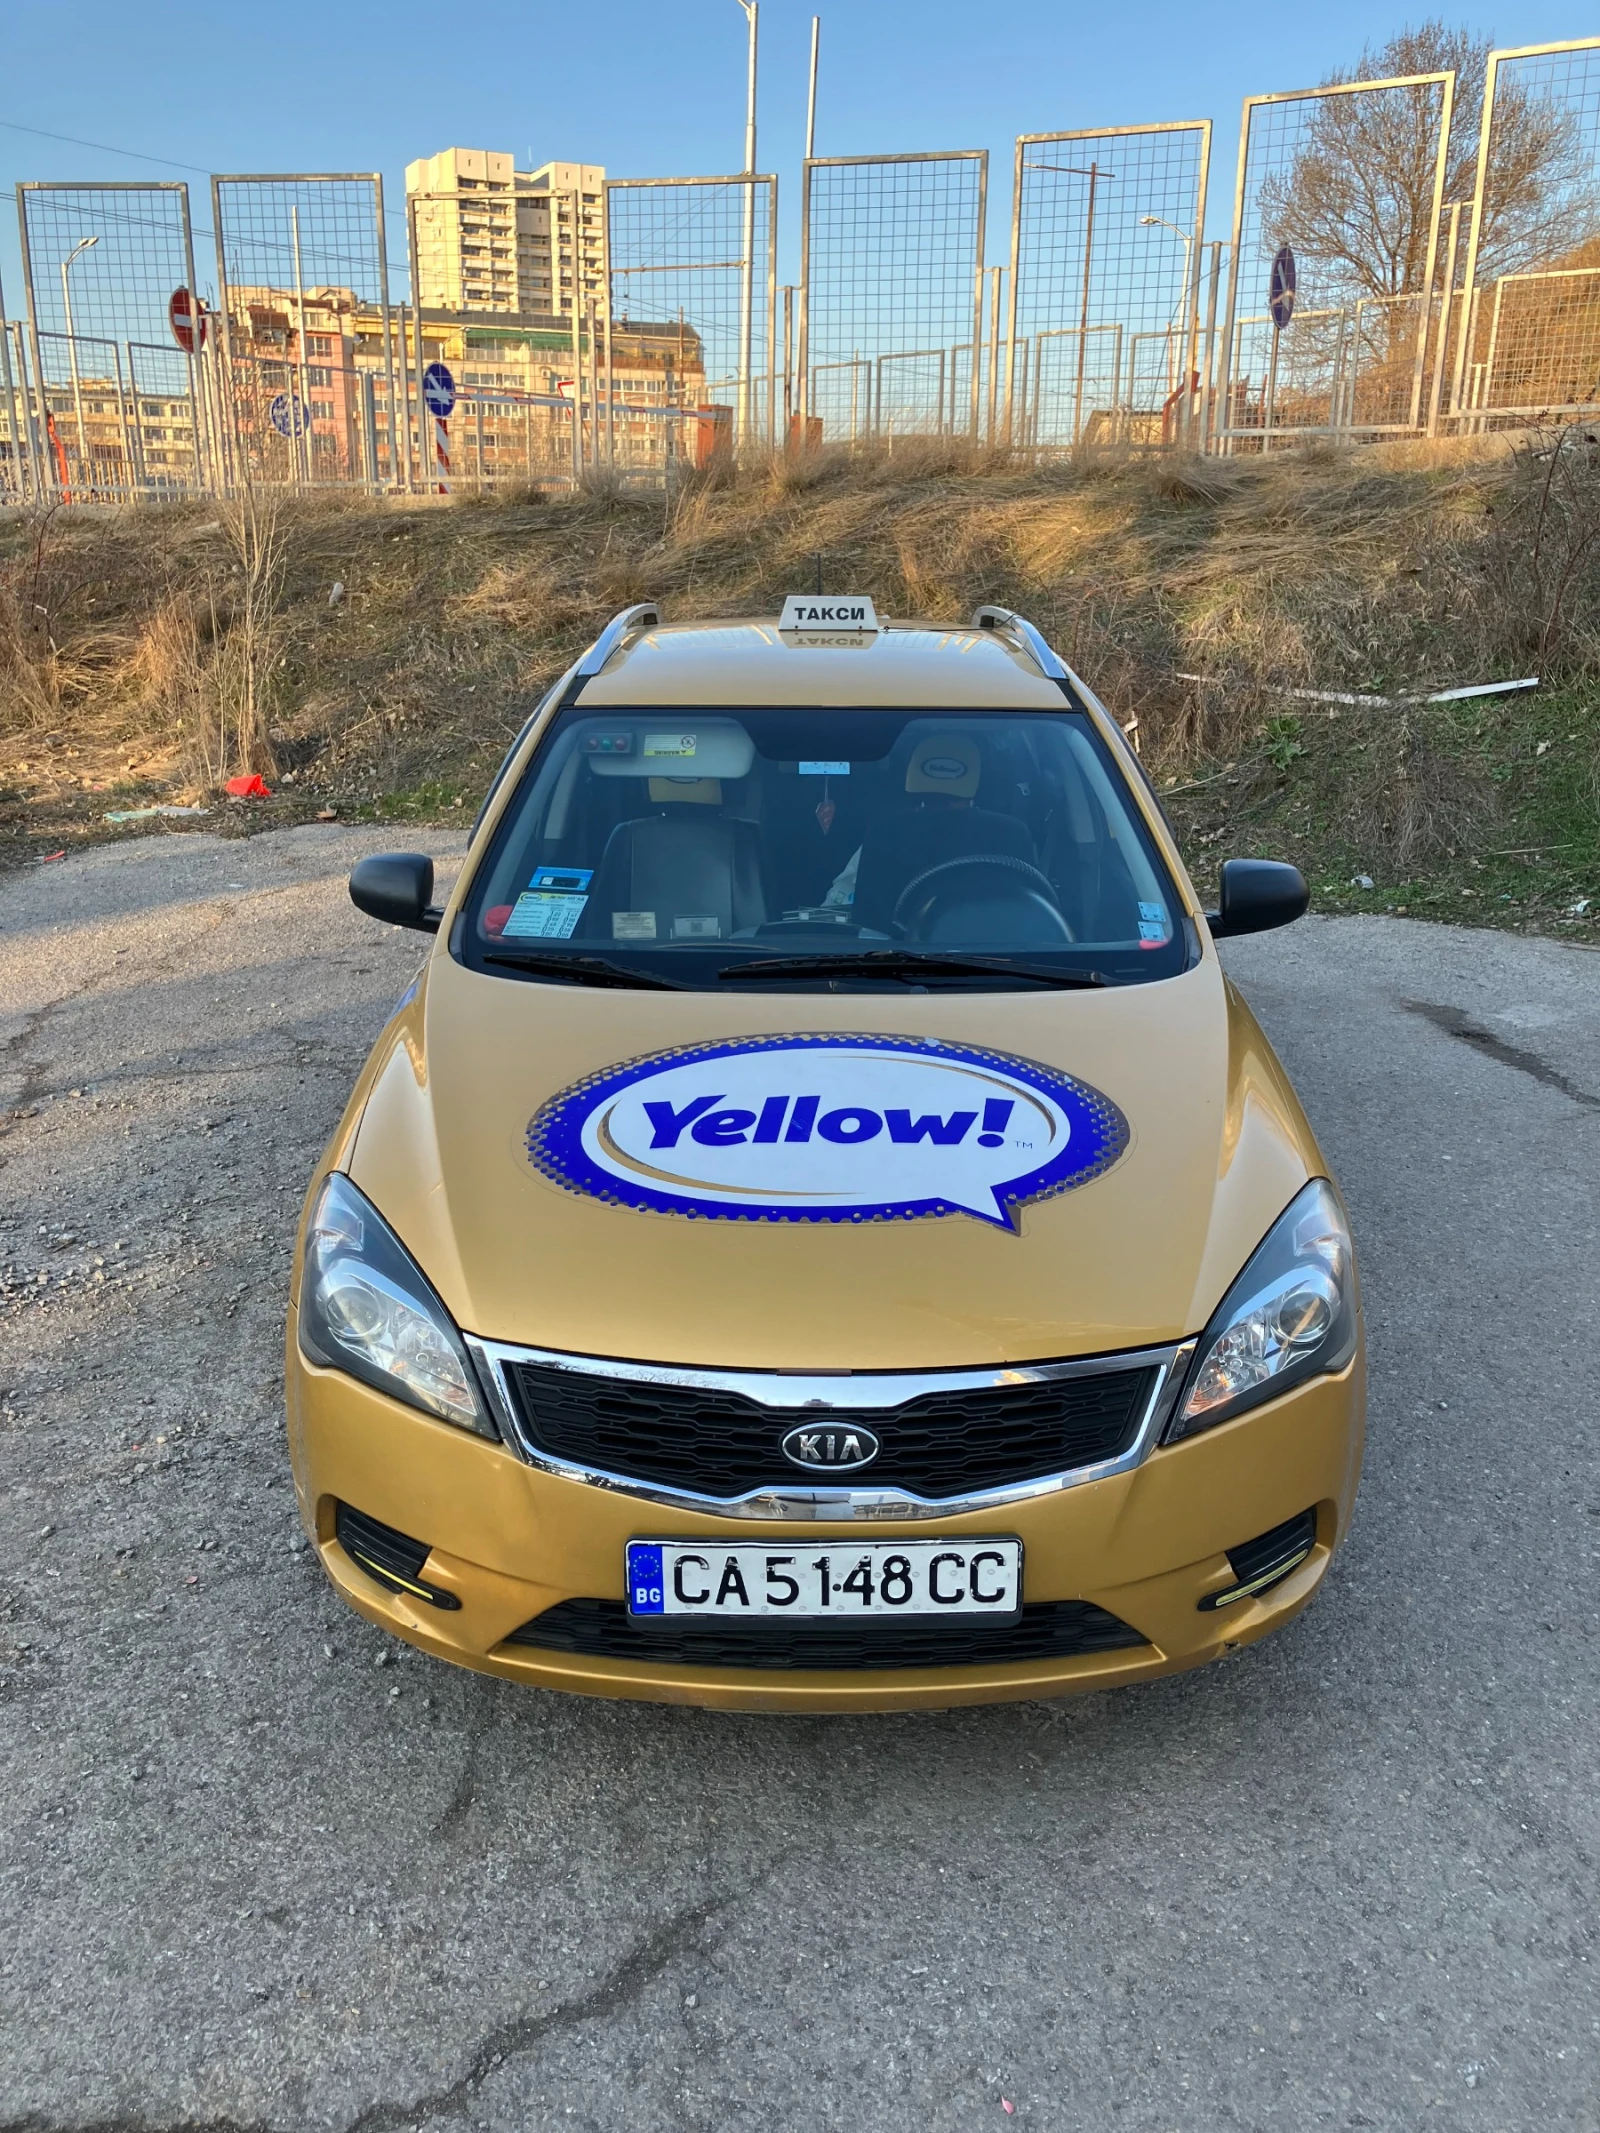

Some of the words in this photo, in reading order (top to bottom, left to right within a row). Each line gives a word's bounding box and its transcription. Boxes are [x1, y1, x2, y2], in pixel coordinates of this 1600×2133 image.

[794, 607, 865, 620] ТАКСИ
[642, 1094, 1016, 1150] Yellow!
[799, 1434, 864, 1460] KIA
[636, 1588, 661, 1604] BG
